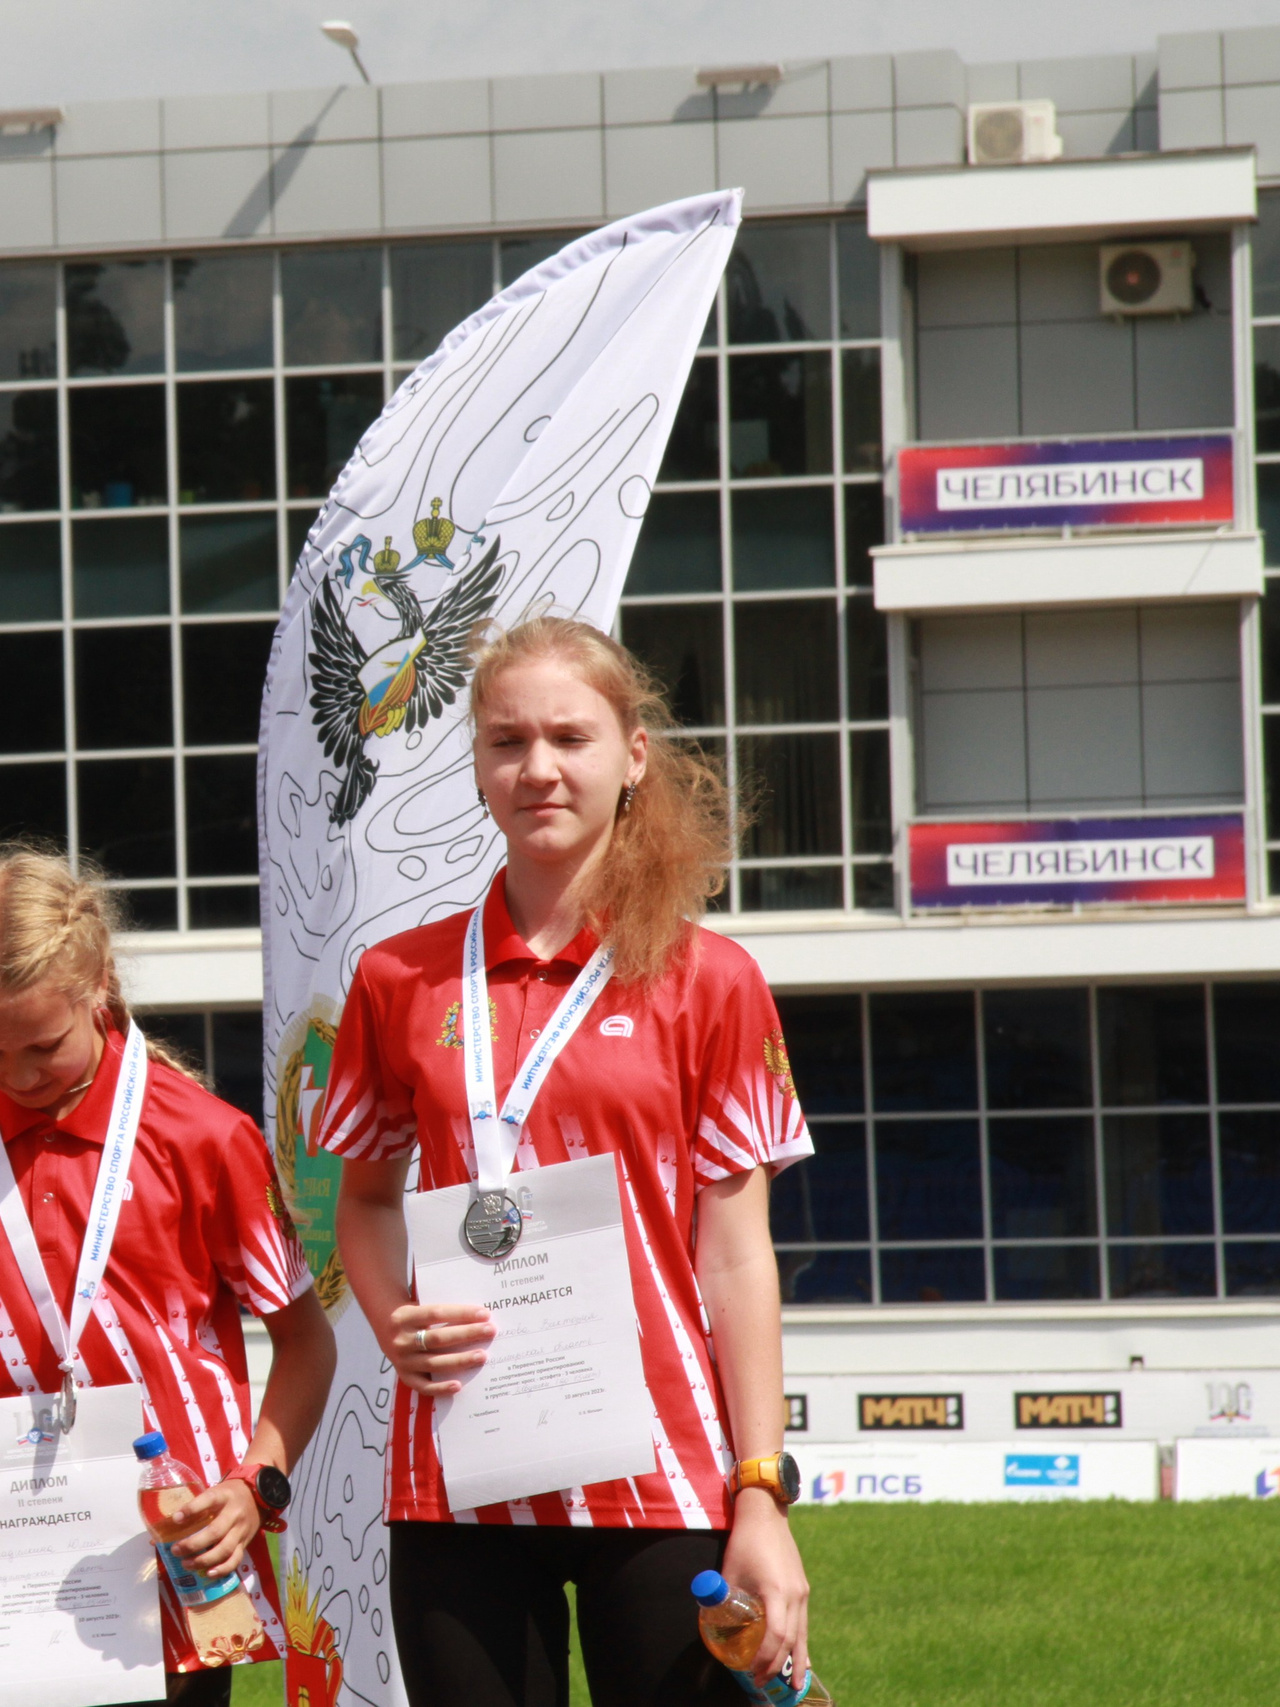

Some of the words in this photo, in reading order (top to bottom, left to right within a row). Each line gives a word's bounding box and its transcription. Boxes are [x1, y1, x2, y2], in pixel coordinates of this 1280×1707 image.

[944, 467, 1194, 501] ЧЕЛЯБИНСК
[954, 845, 1205, 877] ЧЕЛЯБИНСК
[470, 967, 480, 1005] СПОРТА
[557, 968, 602, 1031] РОССИЙСКОЙ
[472, 1009, 484, 1083] МИНИСТЕРСТВО
[521, 1029, 562, 1091] ФЕДЕРАЦИИ
[116, 1061, 138, 1134] РОССИЙСКОЙ
[108, 1132, 125, 1177] СПОРТА
[89, 1175, 117, 1262] МИНИСТЕРСТВО
[493, 1252, 549, 1276] ДИПЛОМ
[510, 1274, 545, 1288] степени
[546, 1355, 566, 1364] России
[9, 1475, 68, 1494] ДИПЛОМ
[855, 1474, 923, 1494] ПСБ
[27, 1496, 64, 1507] степени
[0, 1510, 92, 1530] НАГРАЖДАЕТСЯ
